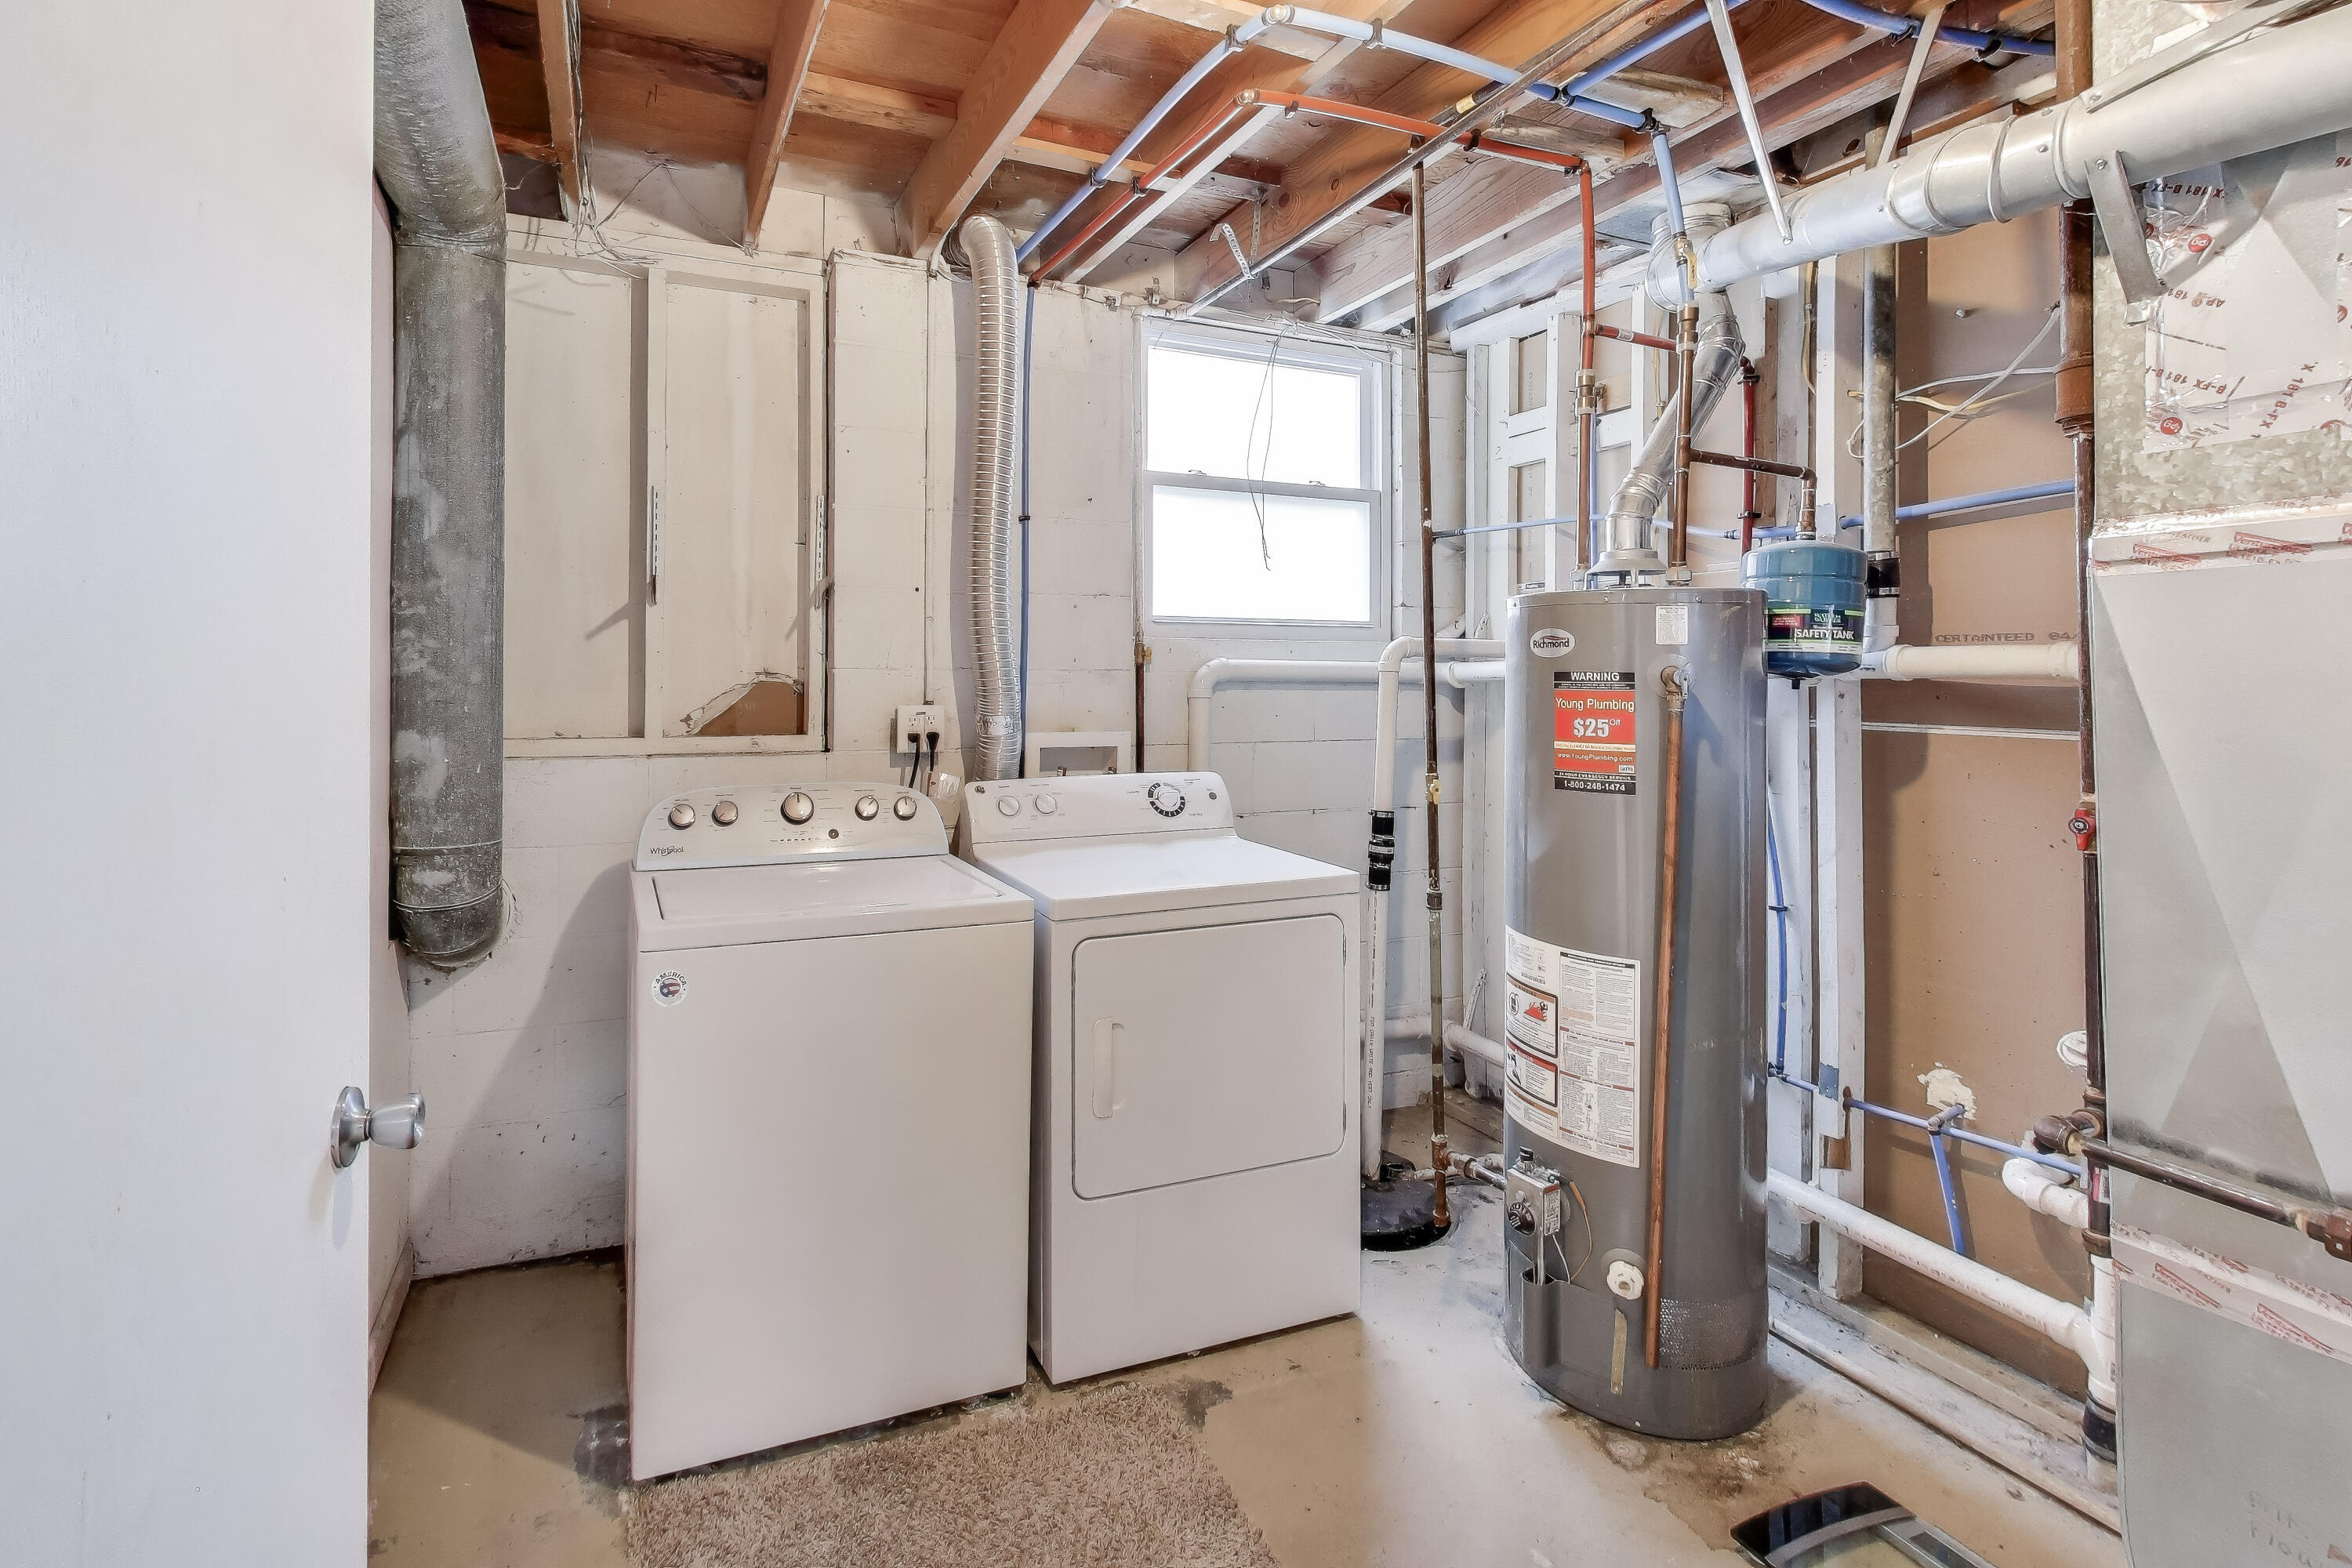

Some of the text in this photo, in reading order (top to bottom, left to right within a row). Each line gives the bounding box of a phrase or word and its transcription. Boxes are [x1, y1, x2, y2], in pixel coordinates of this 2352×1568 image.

[1796, 628, 1855, 640] SAFETY TANK
[1935, 632, 2035, 642] CERTAINTEED
[1533, 638, 1570, 649] Richmond
[1570, 672, 1620, 681] WARNING
[1555, 698, 1635, 713] Young Plumbing
[1573, 717, 1610, 738] $25
[650, 846, 684, 856] Whirlpool
[655, 971, 687, 985] AMERICA
